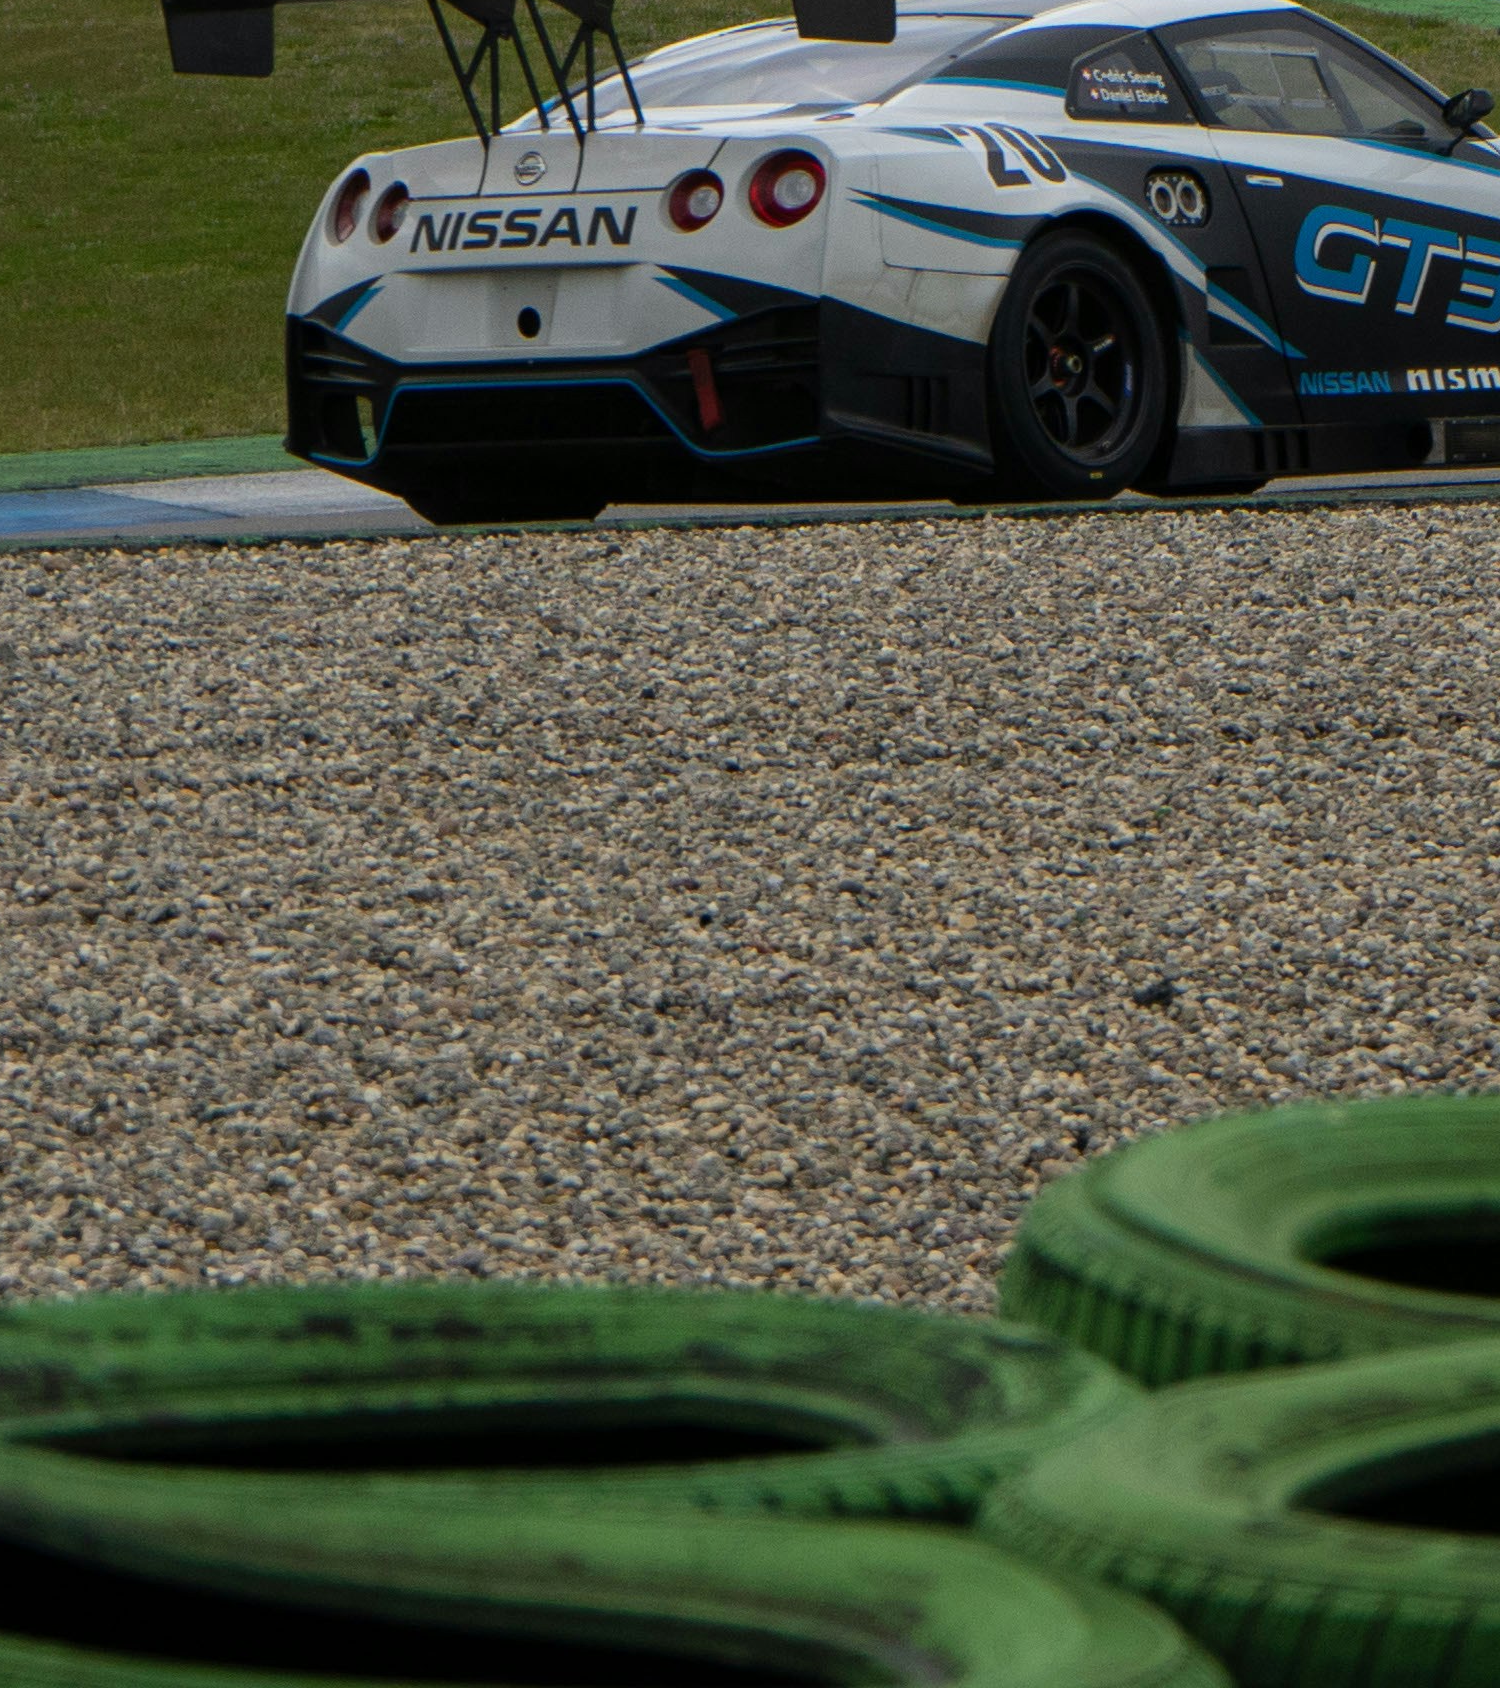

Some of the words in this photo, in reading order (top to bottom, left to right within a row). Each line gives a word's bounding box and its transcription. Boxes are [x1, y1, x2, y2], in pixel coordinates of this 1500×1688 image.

[940, 122, 1066, 187] 20
[410, 206, 639, 253] NISSAN
[1300, 371, 1392, 395] NISSAN
